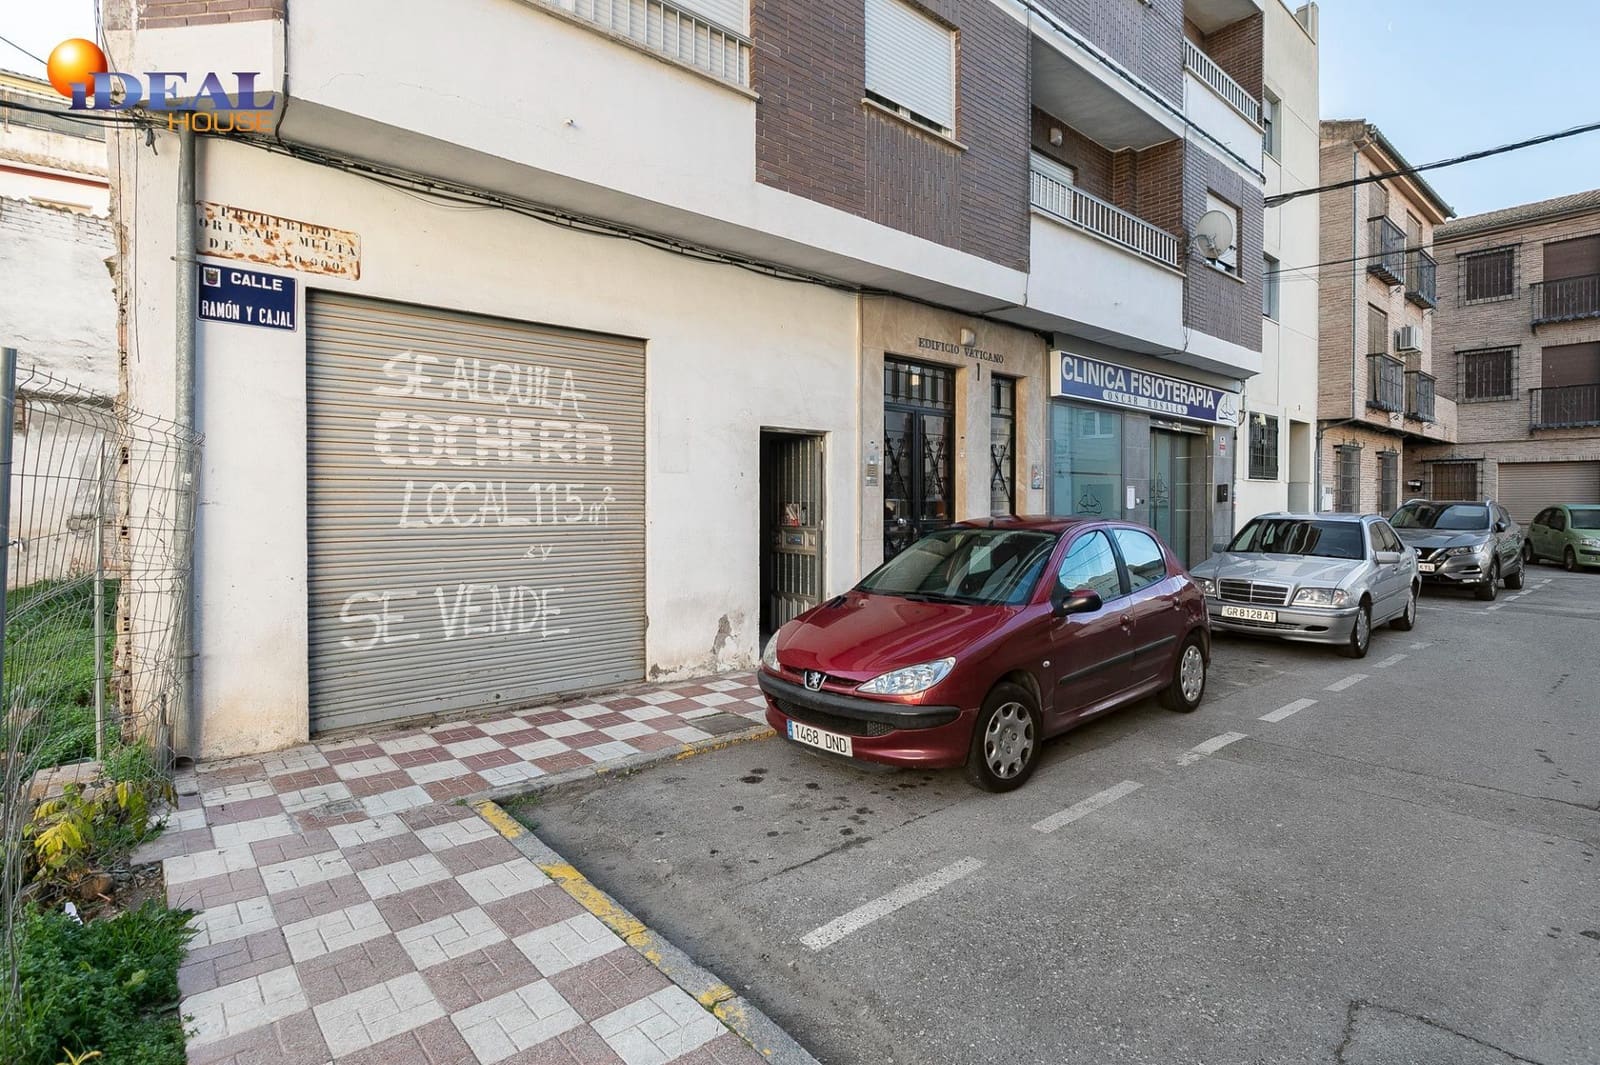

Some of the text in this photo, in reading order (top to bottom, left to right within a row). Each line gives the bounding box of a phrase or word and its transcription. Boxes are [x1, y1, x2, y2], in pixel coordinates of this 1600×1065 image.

[199, 217, 356, 257] ORINAR MULTA
[220, 206, 332, 238] PROHIBIDO
[209, 238, 233, 251] DE
[230, 272, 283, 292] CALLE
[201, 300, 293, 328] RAMÓN Y CAJAL
[918, 337, 1004, 364] EDIFICIO VATICANO
[371, 350, 587, 420] SE ALQUILA
[1062, 356, 1216, 411] CLINICA FISIOTERAPIA
[399, 480, 531, 529] LOCAL
[338, 583, 571, 651] SE VENDE
[795, 724, 847, 753] 1468 DND
